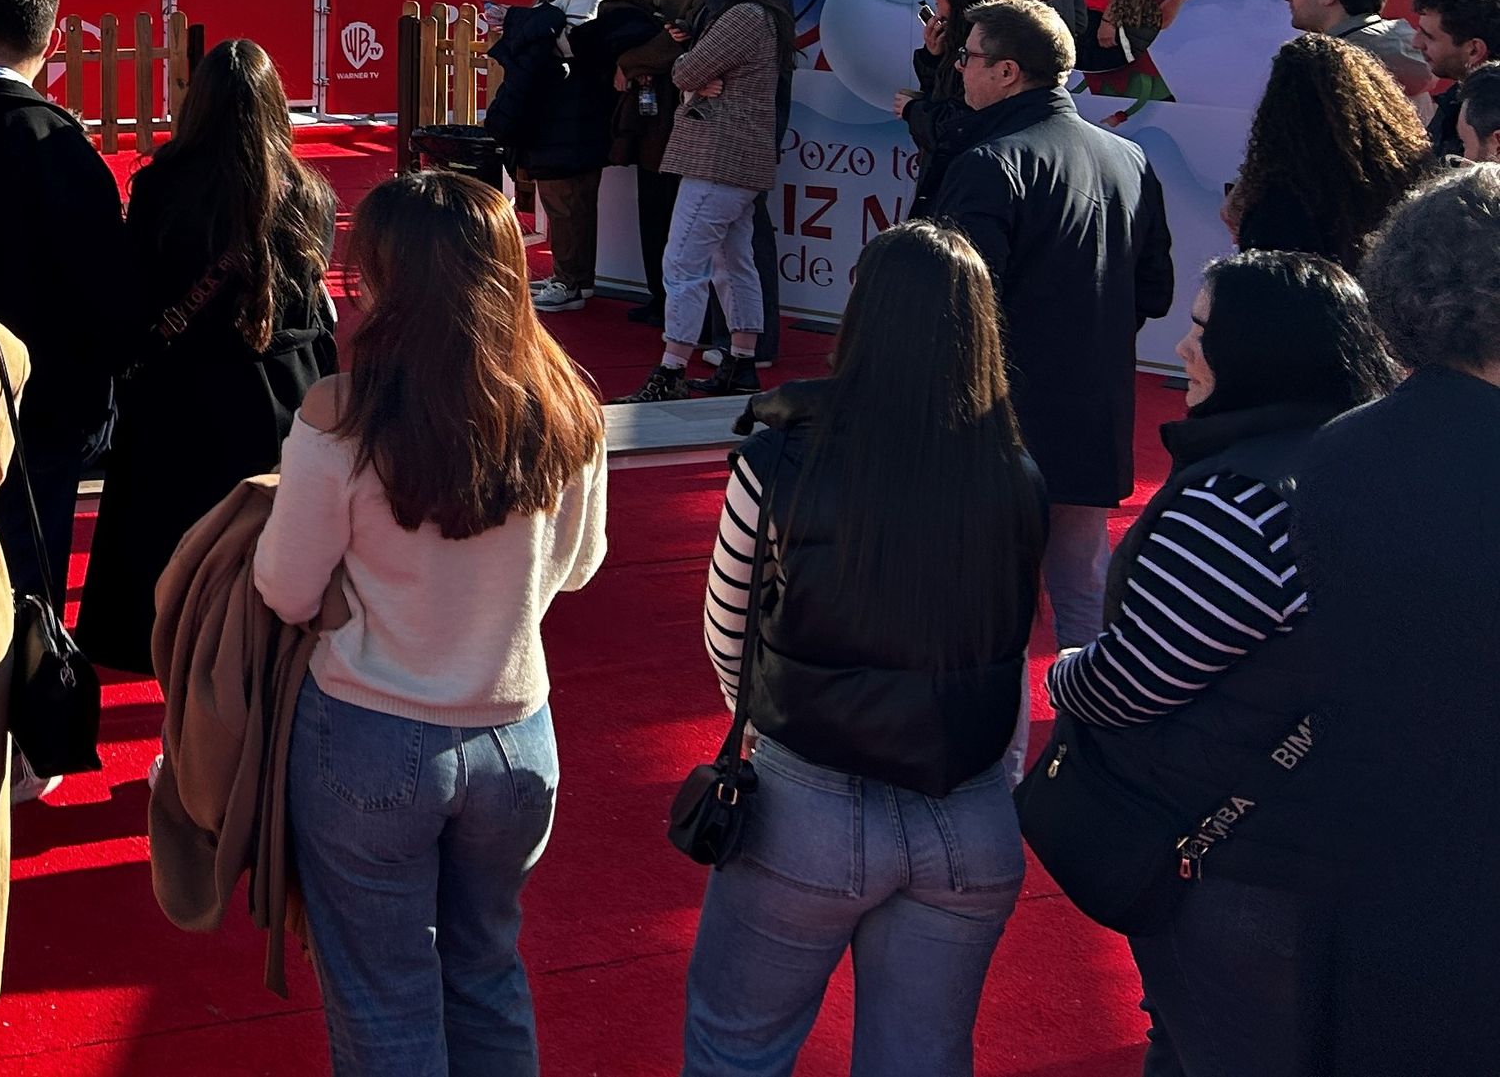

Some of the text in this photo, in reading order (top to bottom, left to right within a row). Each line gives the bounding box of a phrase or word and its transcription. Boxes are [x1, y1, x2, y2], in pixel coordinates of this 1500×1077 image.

[345, 27, 371, 63] WB
[336, 72, 369, 80] WARNER
[779, 244, 834, 288] de
[1271, 715, 1314, 770] BIM
